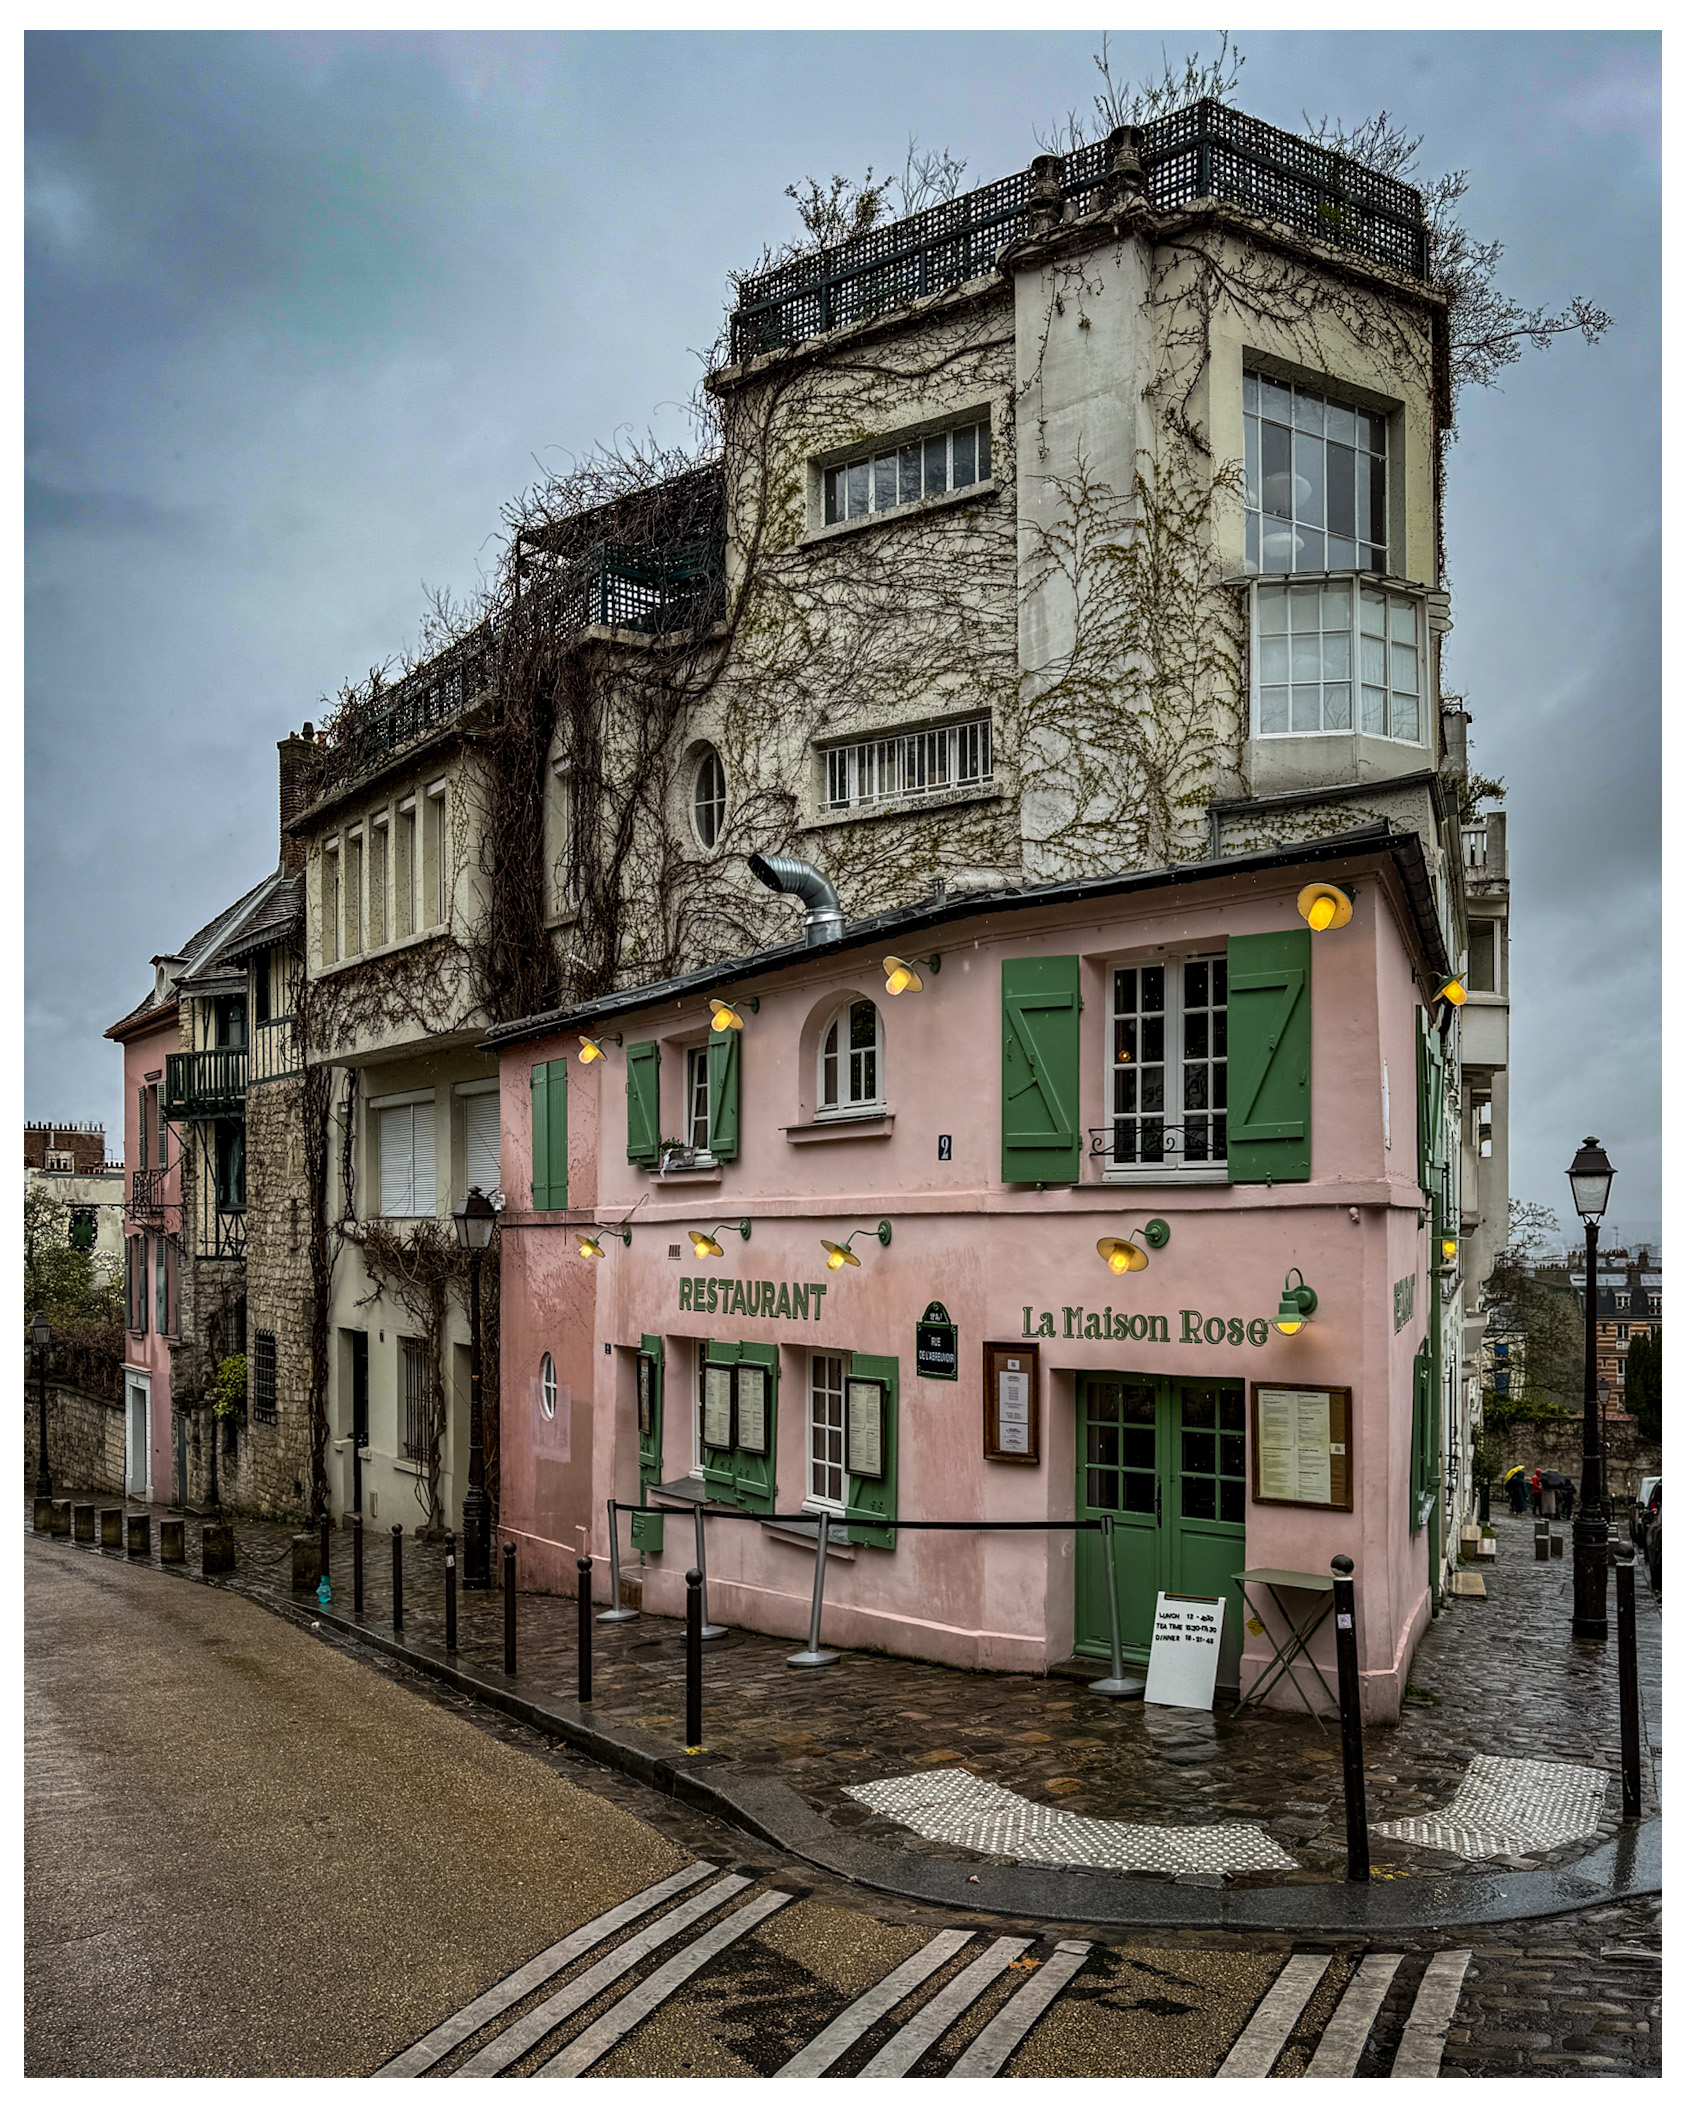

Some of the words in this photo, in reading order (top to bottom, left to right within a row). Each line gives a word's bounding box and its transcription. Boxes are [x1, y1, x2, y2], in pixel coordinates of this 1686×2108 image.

[941, 1136, 949, 1159] 2
[679, 1277, 827, 1321] RESTAURANT
[930, 1336, 941, 1347] RUE
[1021, 1306, 1056, 1338] La
[1061, 1306, 1171, 1343] Maison
[1179, 1309, 1269, 1347] Rose
